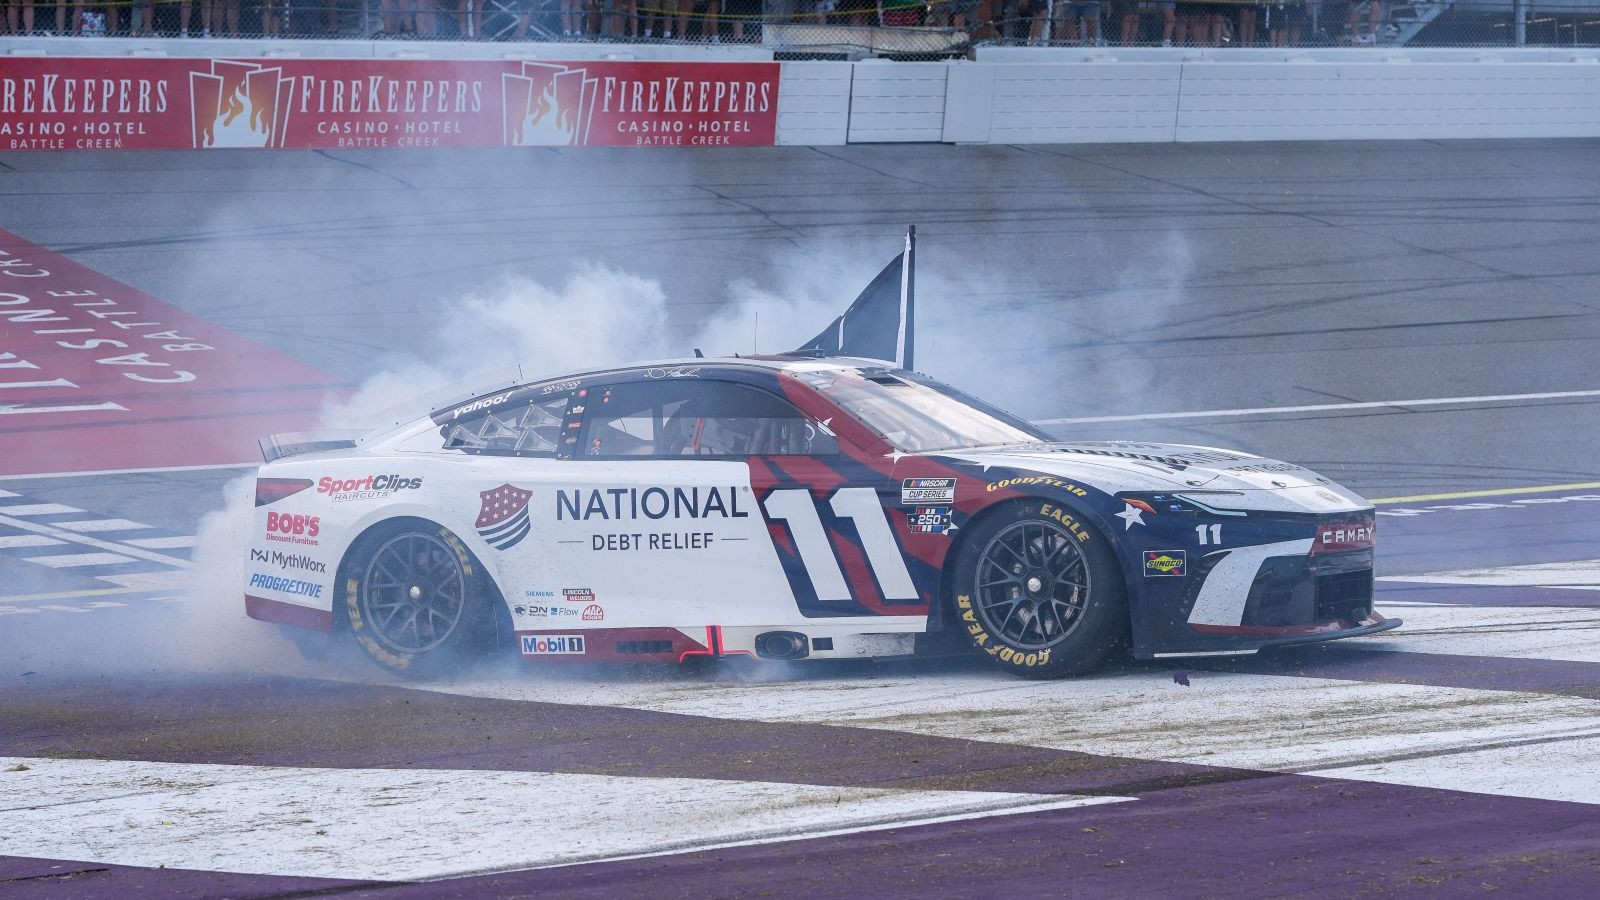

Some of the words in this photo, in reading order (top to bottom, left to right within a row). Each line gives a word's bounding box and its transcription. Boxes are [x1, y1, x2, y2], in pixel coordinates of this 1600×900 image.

[84, 122, 147, 135] HOTEL
[317, 121, 389, 134] CASINO
[405, 121, 462, 134] HOTEL
[617, 120, 684, 133] CASINO
[698, 120, 750, 133] HOTEL
[10, 138, 65, 149] BATTLE
[76, 138, 122, 149] CREEK
[338, 137, 388, 147] BATTLE
[398, 137, 439, 147] CREEK
[636, 135, 682, 145] BATTLE
[691, 135, 730, 145] CREEK
[453, 391, 514, 420] yahoo!
[919, 479, 949, 487] NASCAR
[986, 476, 1087, 497] GOODYEAR
[334, 491, 389, 501] HAIRCUTS
[909, 490, 924, 498] CUP
[923, 490, 947, 498] SERIES
[267, 511, 320, 537] BOB'S
[917, 514, 941, 525] 250
[1040, 503, 1090, 543] EAGLE
[1195, 523, 1222, 545] 11
[1322, 526, 1374, 544] CAMRY
[592, 534, 643, 551] DEBT
[649, 533, 714, 550] RELIEF
[764, 487, 920, 600] 11
[271, 550, 326, 573] MythWorx
[1147, 560, 1182, 568] SUNOCO
[250, 573, 323, 598] PROGRESSIVE
[559, 607, 579, 616] Flow
[523, 637, 566, 652] Mobil
